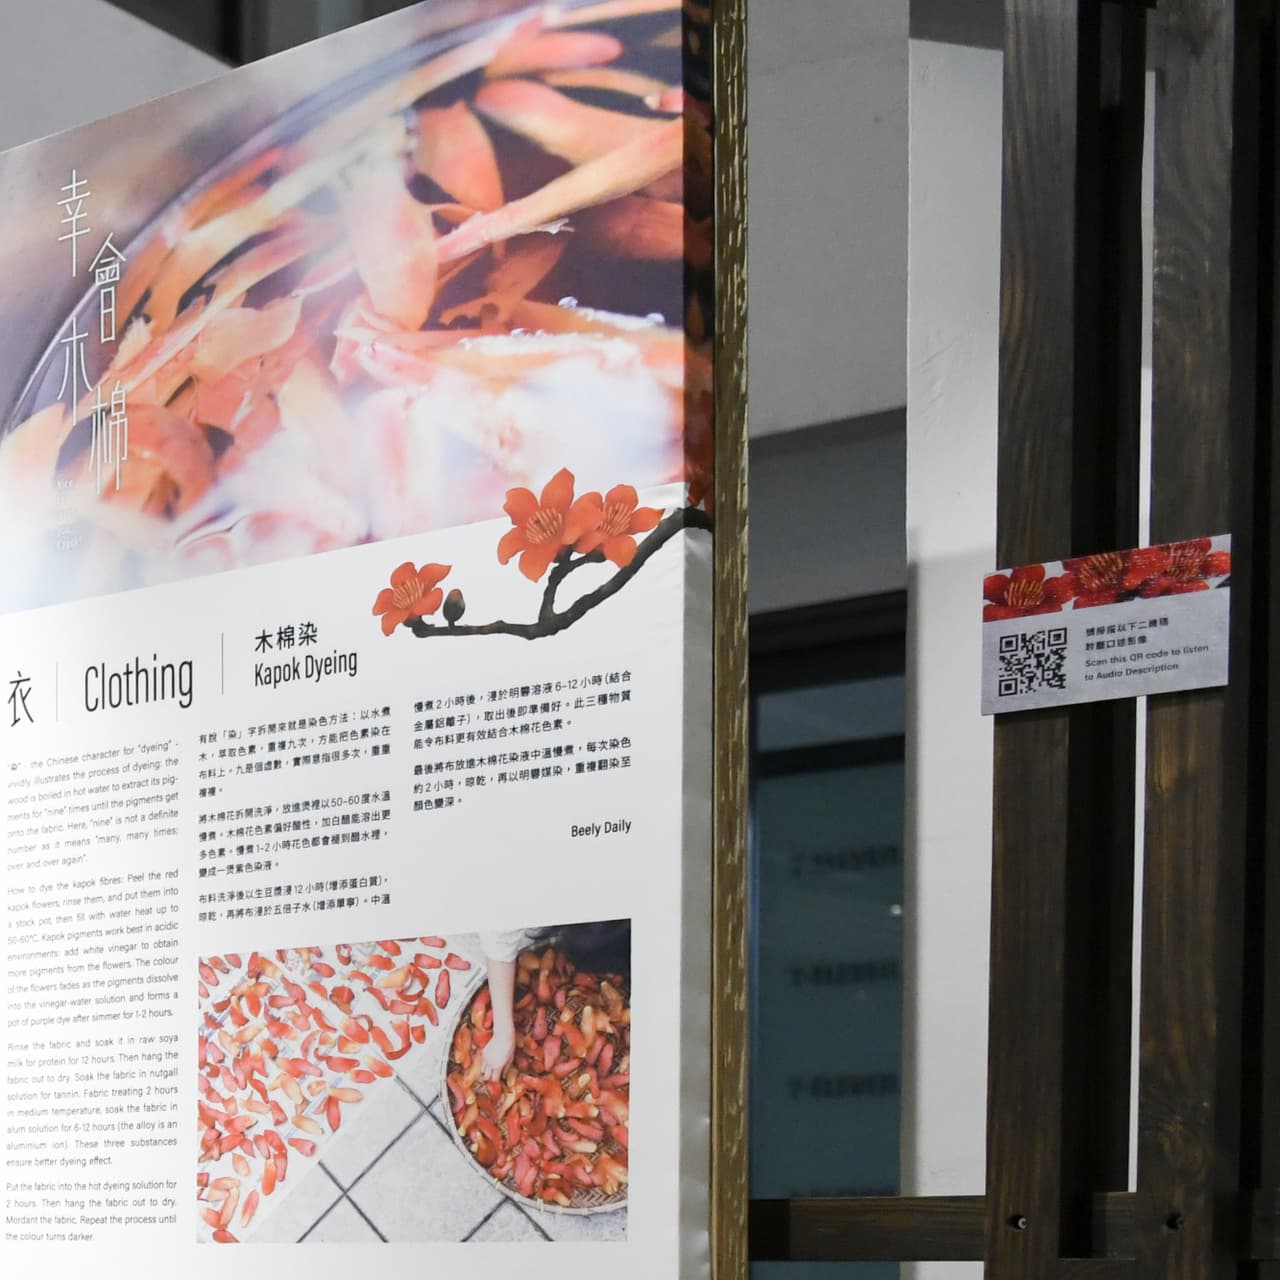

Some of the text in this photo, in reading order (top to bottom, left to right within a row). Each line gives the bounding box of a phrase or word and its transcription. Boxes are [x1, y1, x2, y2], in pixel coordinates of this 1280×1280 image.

[57, 169, 128, 495] 幸會木棉
[254, 621, 318, 653] 木棉染
[1085, 645, 1209, 668] Scan this QR code to listen
[254, 650, 357, 689] Kapok Dyeing
[1096, 670, 1123, 679] Audio
[1125, 663, 1179, 676] Description
[84, 653, 193, 712] Clothing
[7, 670, 34, 727] 衣
[164, 757, 179, 767] the
[164, 791, 179, 804] get
[571, 818, 632, 838] Beely Daily
[126, 871, 145, 882] Peel
[147, 871, 162, 880] the
[164, 867, 179, 879] red
[158, 1034, 179, 1045] soya
[163, 1050, 179, 1059] the
